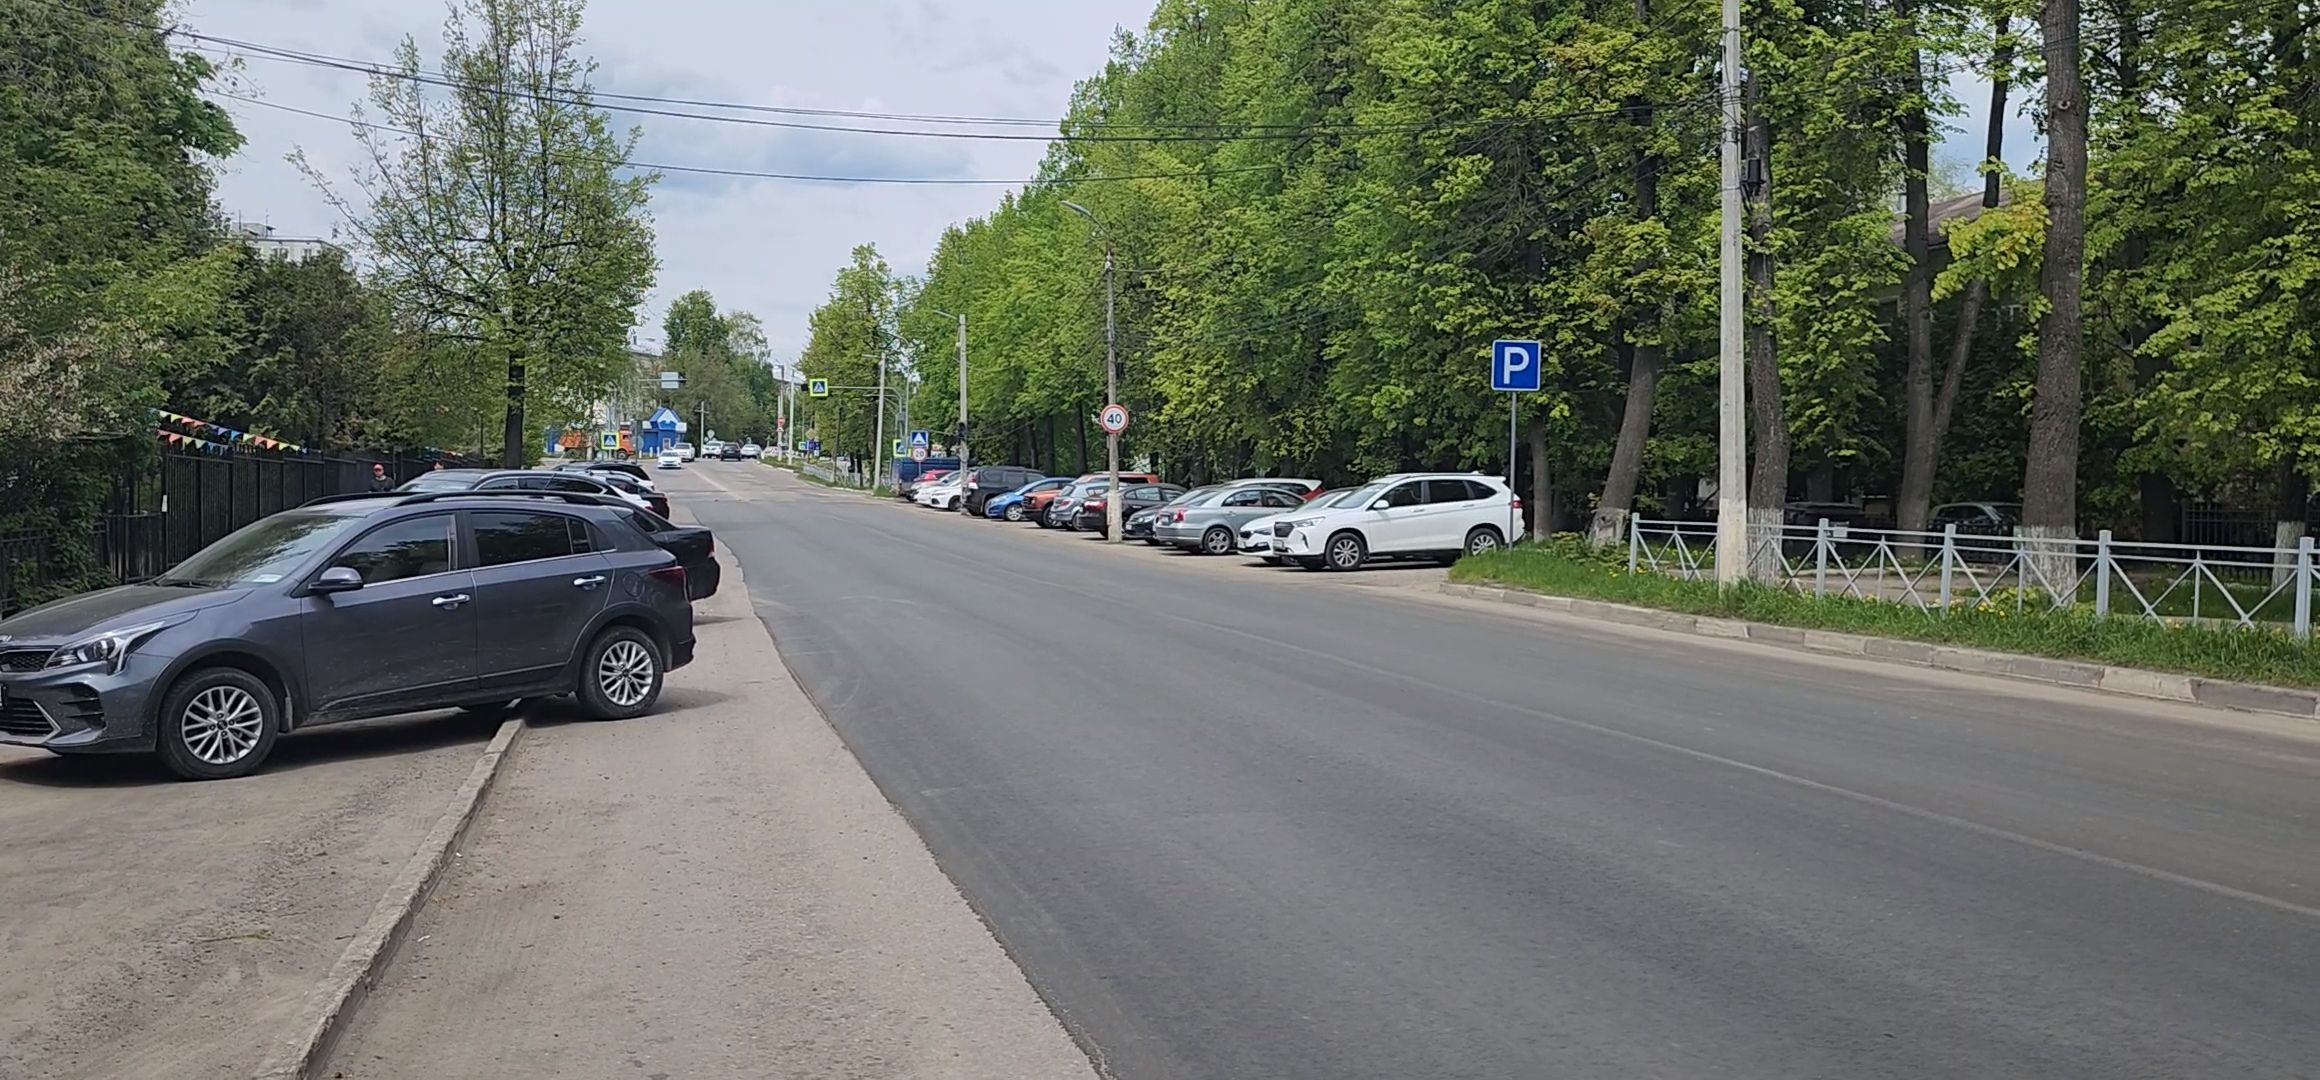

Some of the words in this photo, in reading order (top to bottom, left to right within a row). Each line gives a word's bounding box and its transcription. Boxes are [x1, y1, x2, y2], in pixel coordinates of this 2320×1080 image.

[1503, 346, 1529, 385] P
[1107, 413, 1122, 424] 40
[915, 450, 925, 458] 20
